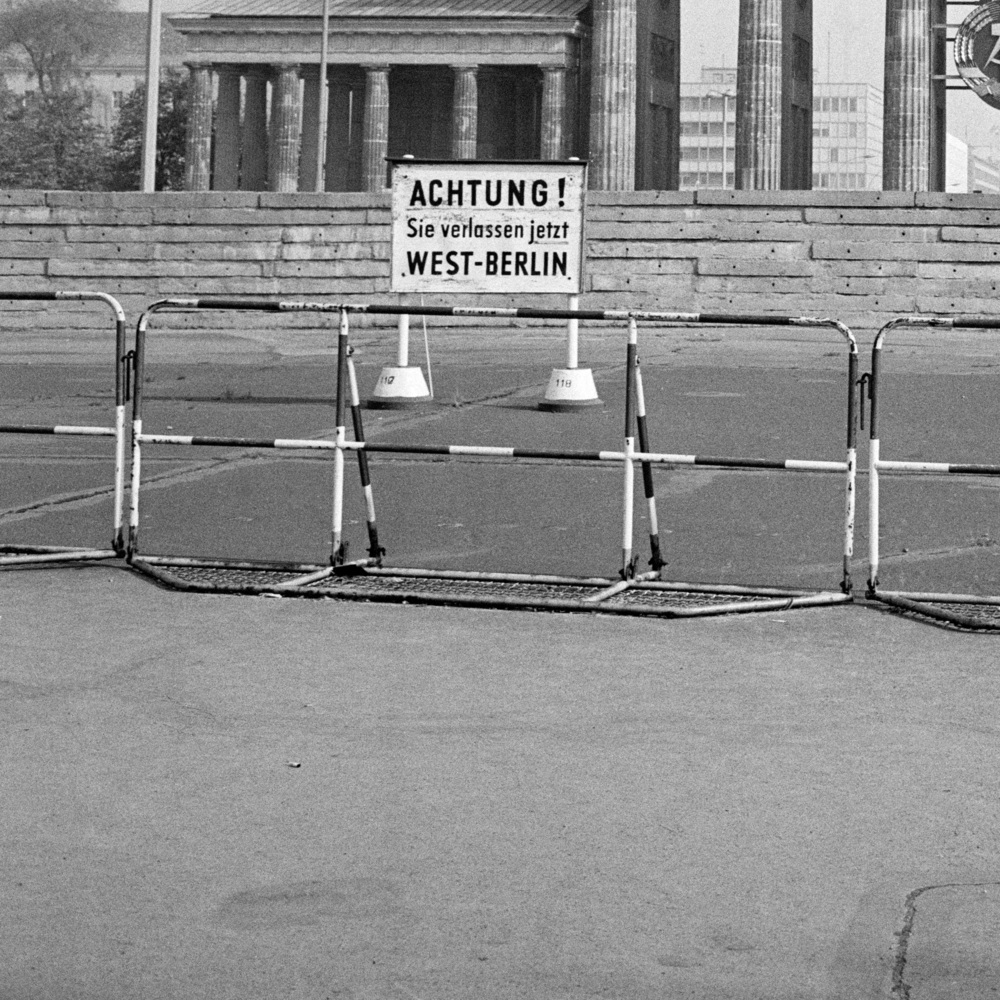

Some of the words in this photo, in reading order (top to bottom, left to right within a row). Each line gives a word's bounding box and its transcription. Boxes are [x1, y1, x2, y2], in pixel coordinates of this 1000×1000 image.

[407, 217, 435, 238] Sie
[441, 217, 524, 239] verlassen
[528, 220, 569, 245] jetzt
[406, 251, 568, 277] WEST-BERLIN
[556, 379, 572, 388] 118
